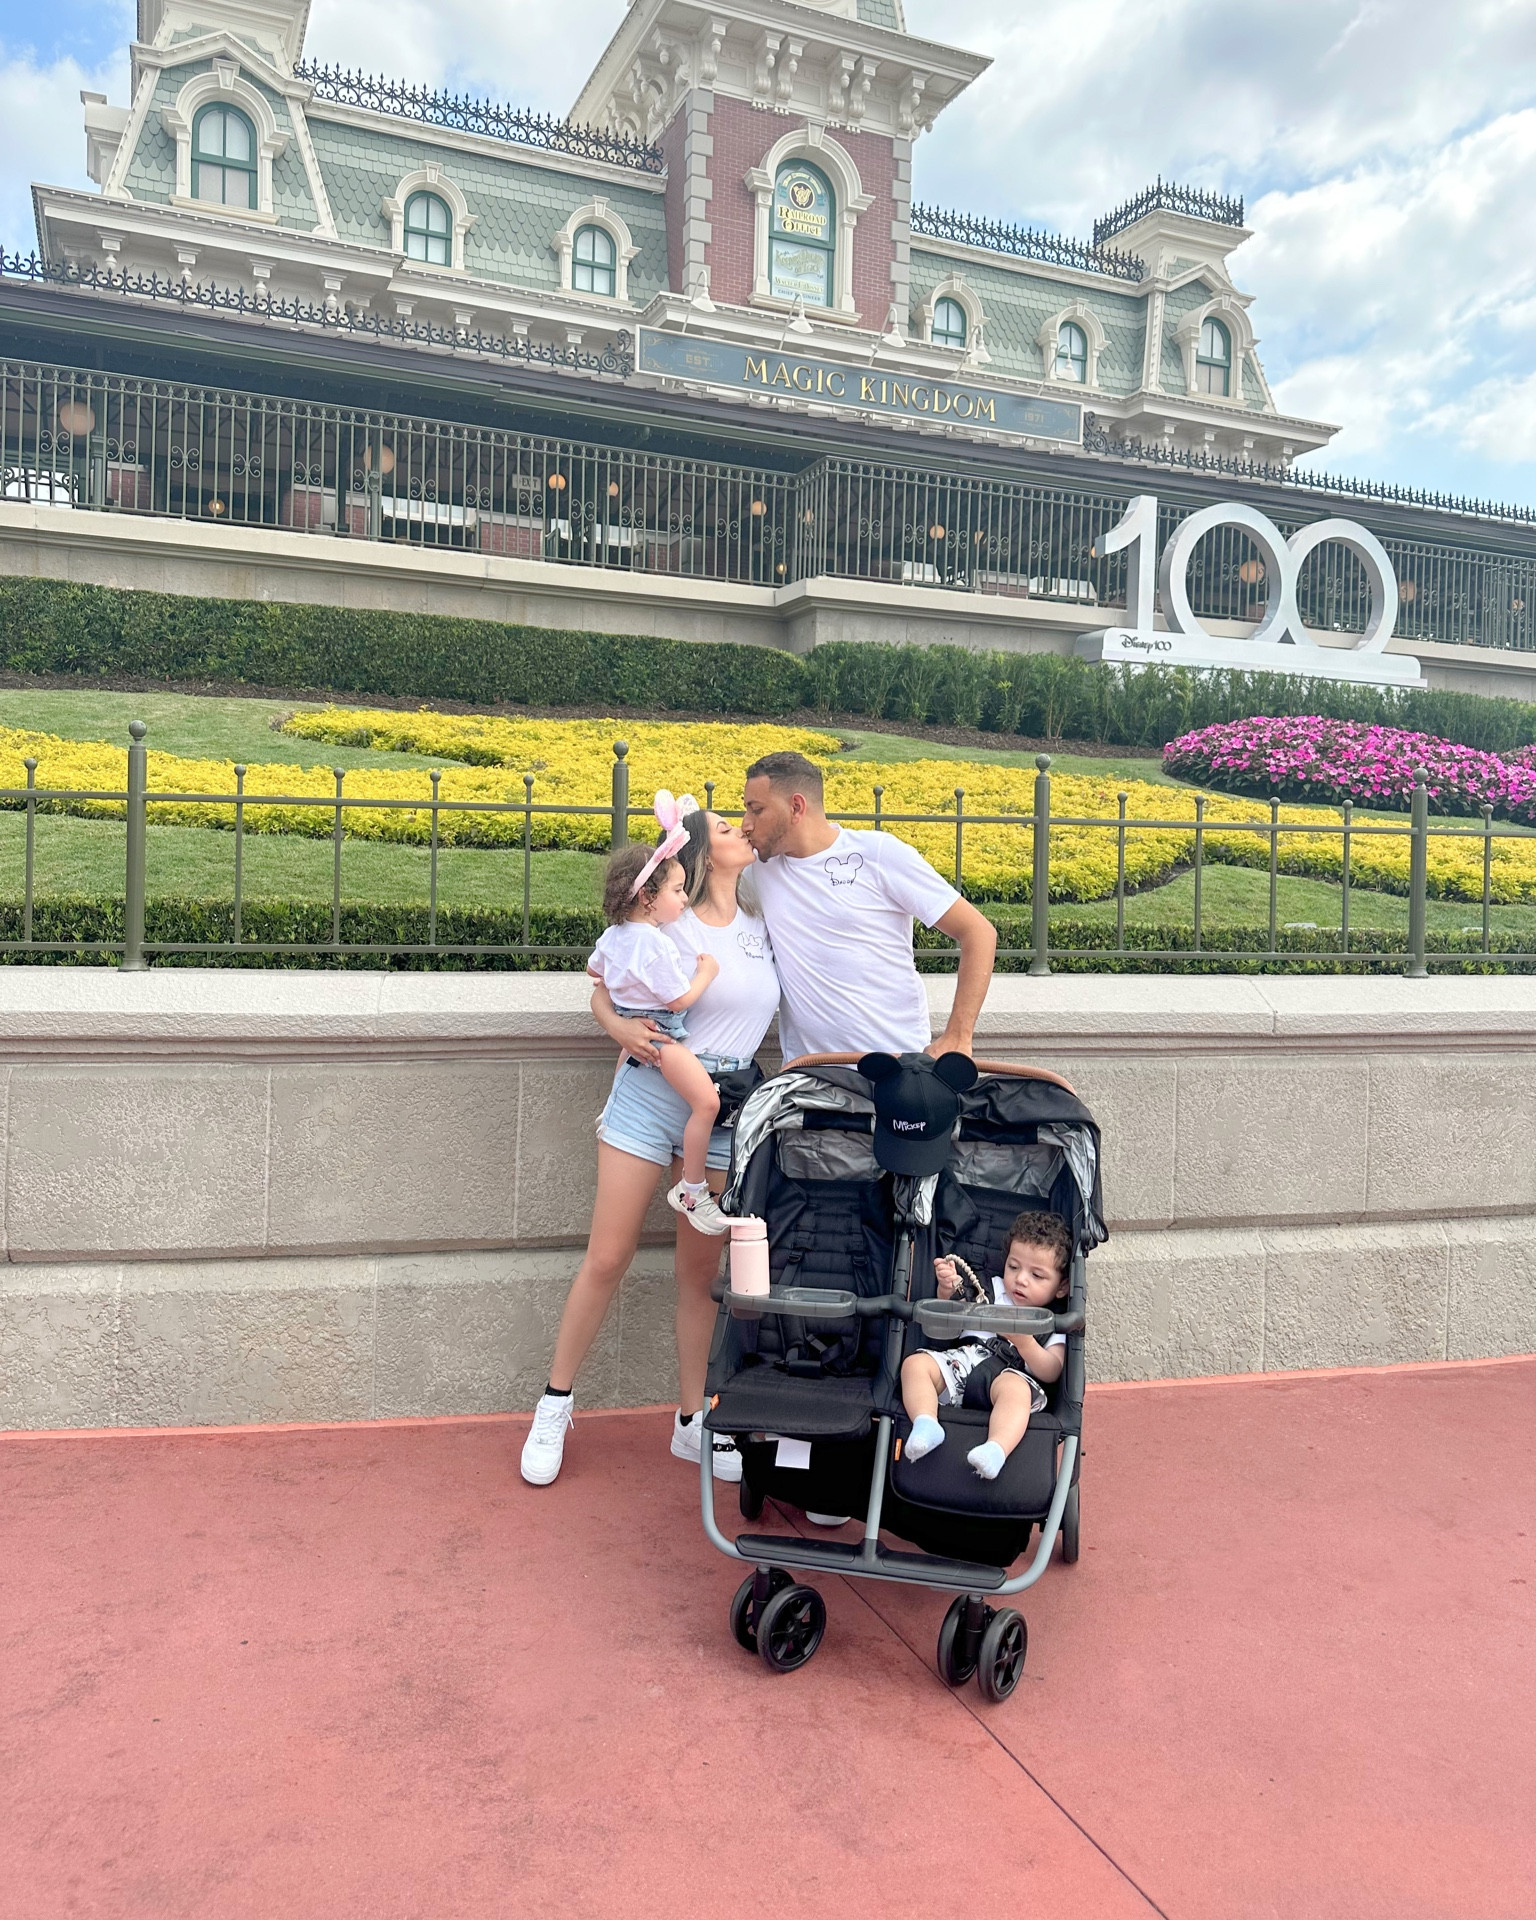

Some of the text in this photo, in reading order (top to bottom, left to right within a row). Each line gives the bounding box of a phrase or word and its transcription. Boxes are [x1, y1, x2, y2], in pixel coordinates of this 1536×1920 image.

[743, 355, 997, 423] MAGIC KINGDOM
[1094, 494, 1399, 655] 100
